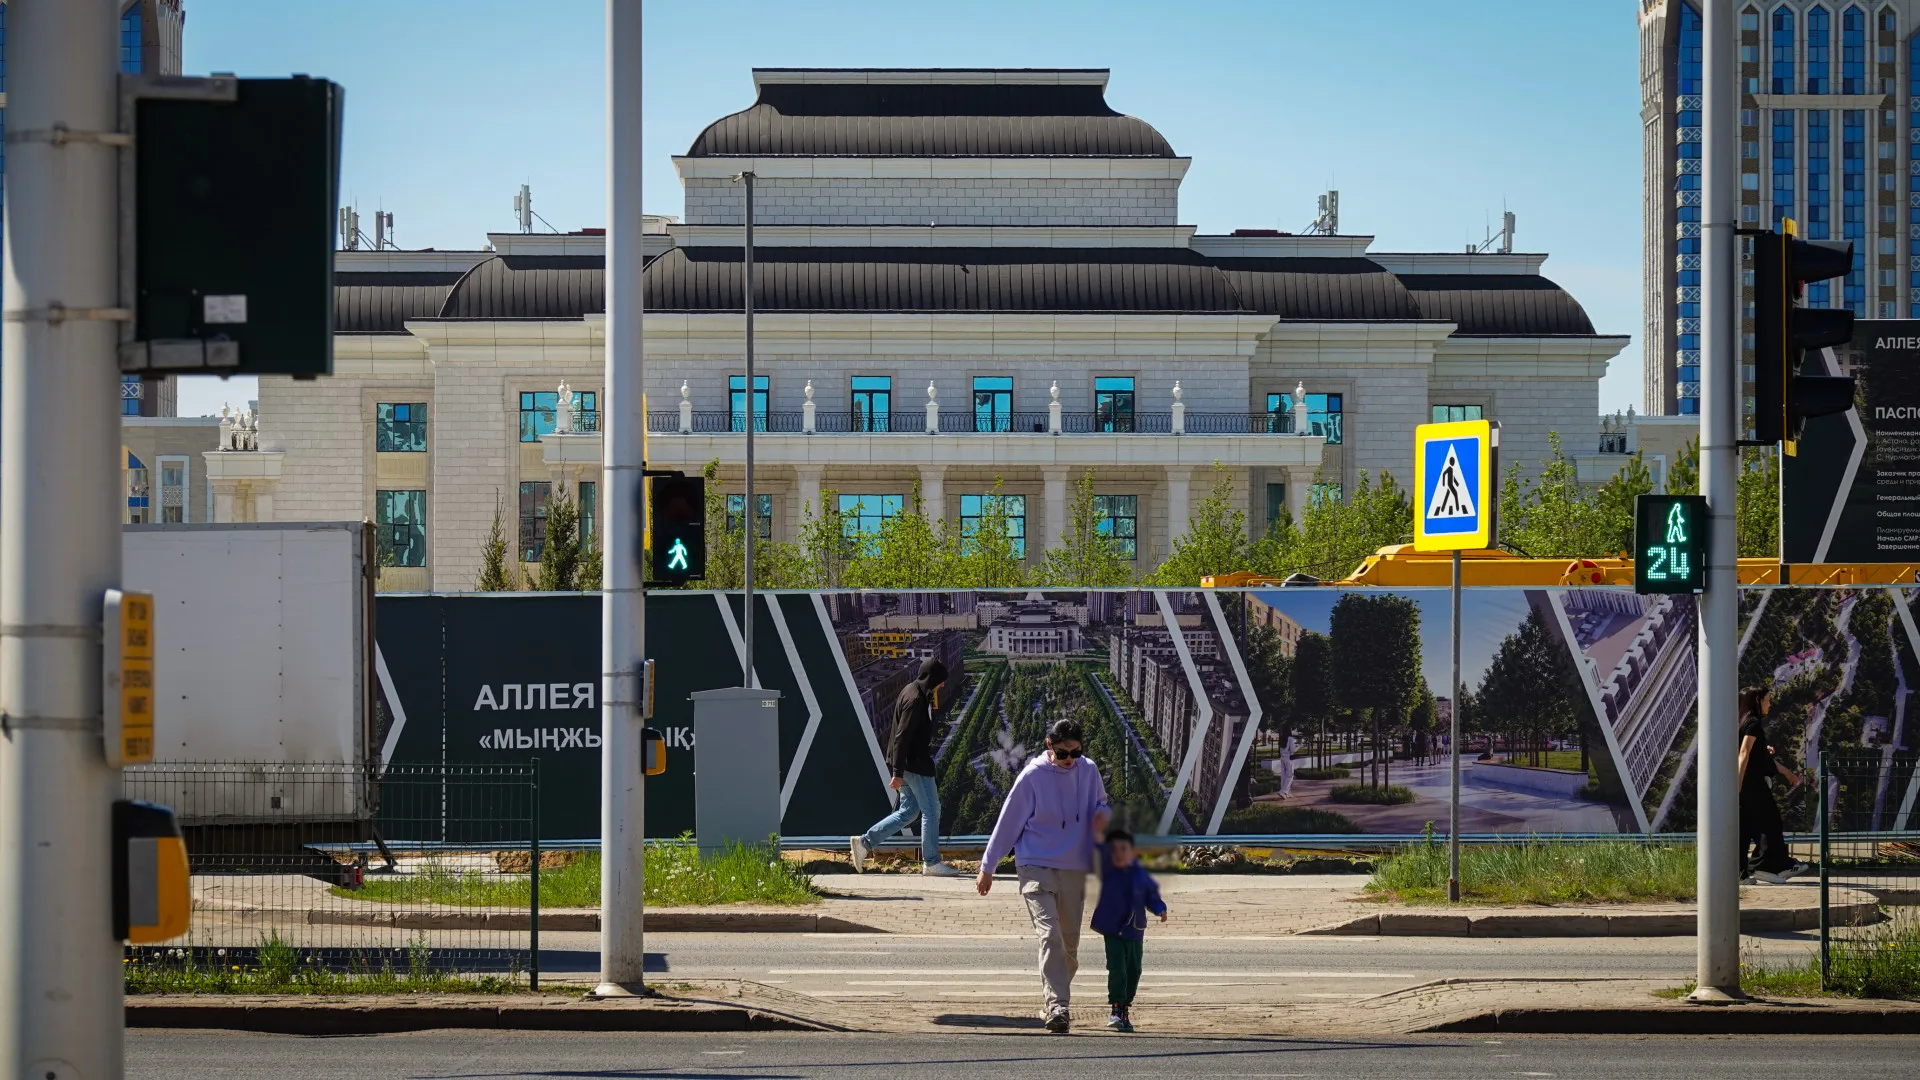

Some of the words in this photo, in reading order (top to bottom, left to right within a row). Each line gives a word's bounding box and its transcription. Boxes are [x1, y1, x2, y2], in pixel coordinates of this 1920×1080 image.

[1876, 510, 1901, 518] Общая
[1647, 546, 1690, 580] 24
[473, 683, 595, 711] АЛЛЕЯ
